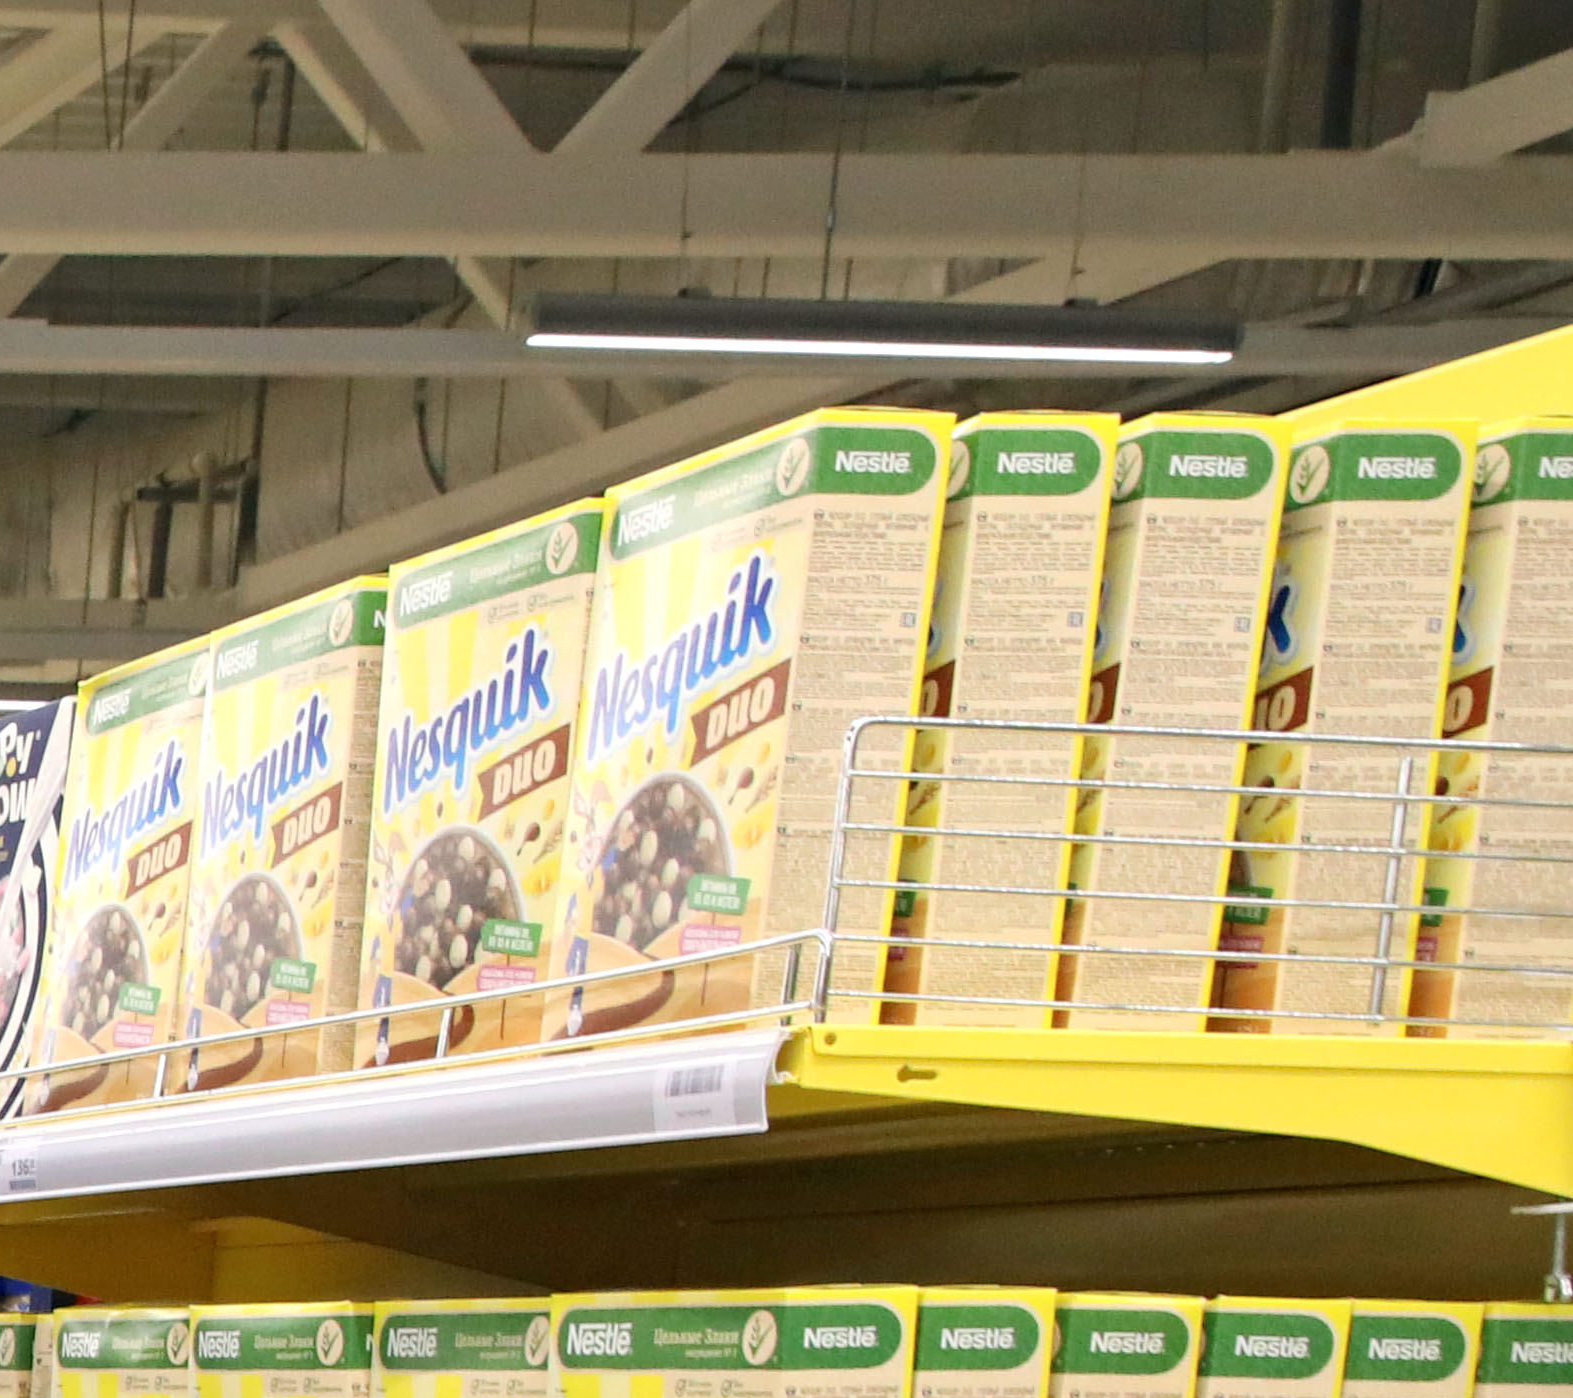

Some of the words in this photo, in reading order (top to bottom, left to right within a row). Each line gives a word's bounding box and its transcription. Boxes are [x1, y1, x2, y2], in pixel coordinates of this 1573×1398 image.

[835, 450, 912, 475] Nestlé
[997, 451, 1076, 476] Nestlé
[1165, 454, 1248, 479] Nestlé
[1357, 456, 1438, 481] Nestlé
[588, 556, 775, 762] Nesquik
[384, 628, 551, 814] Nesquik
[706, 676, 776, 750] DUO
[201, 695, 329, 861] Nesquik
[491, 739, 557, 806] DUO
[65, 741, 182, 891] Nesquik
[282, 796, 332, 854] DUO
[135, 834, 182, 887] DUO
[387, 1327, 437, 1358] Nestlé
[803, 1327, 878, 1350] Nestlé
[940, 1328, 1014, 1350] Nestlé
[1090, 1332, 1166, 1355] Nestlé
[1234, 1335, 1310, 1359] Nestlé
[1368, 1339, 1442, 1363] Nestlé
